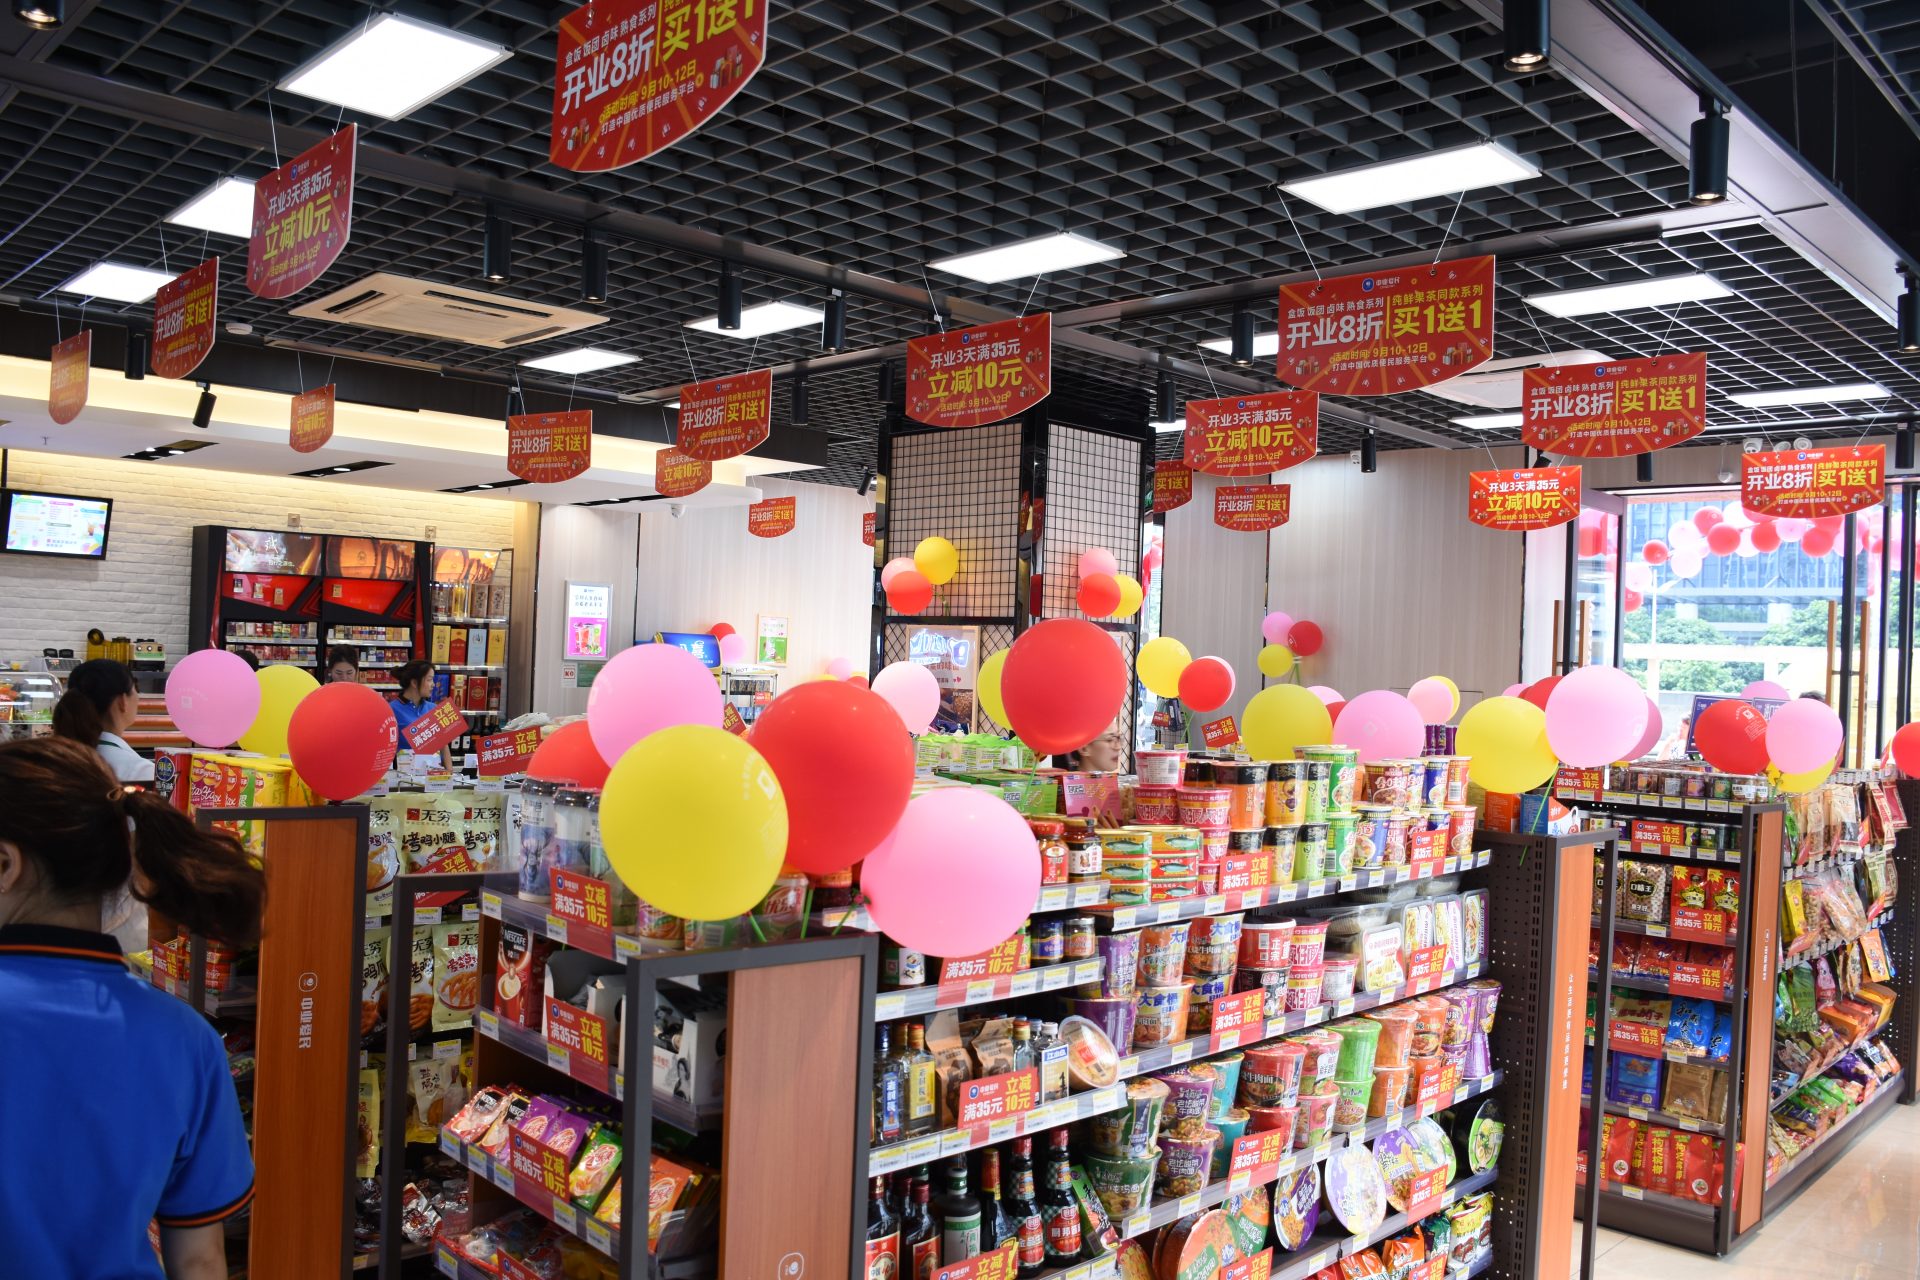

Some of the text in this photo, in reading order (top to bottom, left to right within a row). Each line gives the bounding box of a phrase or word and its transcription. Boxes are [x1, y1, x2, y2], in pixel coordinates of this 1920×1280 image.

[561, 25, 656, 116] 开业8折
[601, 81, 695, 136] 打造中国优质便民服务平台
[268, 165, 332, 219] 开业3天满35元
[263, 193, 332, 261] 立减10元
[1392, 284, 1483, 306] 纯鲜果茶同款系列
[156, 308, 185, 343] 开业8折
[186, 296, 212, 328] 买1送1
[1286, 299, 1481, 351] 开业8折 买1送1
[930, 339, 1021, 369] 开业3天满35元
[1332, 354, 1428, 372] 打造中国优质便民服务平台
[927, 358, 1023, 399] 立减10元
[1530, 386, 1696, 421] 开业8折 买1送1
[682, 406, 725, 431] 开业8折
[727, 399, 766, 423] 买1送1
[1207, 407, 1292, 429] 开业3天满35元
[1204, 424, 1294, 453] 立减10元
[1569, 427, 1651, 439] 打造中国优质便民服务平台
[511, 435, 588, 455] 开业8折 买1送1
[664, 462, 702, 482] 立减10元
[1747, 467, 1877, 491] 开业8折 买1送1
[1156, 477, 1189, 490] 买1送1
[1488, 479, 1560, 493] 开业3天满35元
[1218, 499, 1287, 512] 开业8折 买1送1
[1486, 492, 1561, 512] 立减10元
[750, 510, 794, 523] 开业8折 买1送1
[434, 701, 454, 720] 立减
[439, 713, 459, 728] 10元
[412, 723, 440, 747] 满35元
[515, 730, 537, 744] 立减
[481, 745, 515, 762] 满35元
[516, 743, 537, 755] 10元
[1556, 778, 1581, 787] 满35元
[1582, 772, 1599, 781] 立减
[1583, 780, 1599, 789] 10元
[421, 809, 450, 822] 无穷
[473, 807, 500, 820] 无穷
[1634, 831, 1660, 841] 满35元
[1662, 825, 1680, 836] 立减
[1662, 834, 1680, 844] 10元
[442, 851, 466, 872] 立减
[1250, 855, 1268, 871] 立减
[1222, 872, 1249, 889] 满35元
[1250, 870, 1268, 886] 10元
[584, 883, 607, 906] 立减
[554, 893, 585, 919] 满35元
[585, 904, 608, 928] 10元
[1674, 917, 1702, 929] 满35元
[1703, 913, 1722, 924] 立减
[1703, 922, 1722, 932] 10元
[945, 957, 986, 979] 满35元
[988, 955, 1014, 974] 10元
[1701, 968, 1720, 979] 立减
[1672, 972, 1700, 984] 满35元
[1701, 977, 1720, 987] 10元
[1243, 992, 1262, 1010] 立减
[1214, 1011, 1242, 1031] 满35元
[1243, 1006, 1260, 1022] 10元
[550, 1020, 581, 1050] 满35元
[580, 1015, 603, 1041] 立减
[1613, 1029, 1640, 1042] 满35元
[1640, 1027, 1658, 1038] 立减
[581, 1038, 605, 1062] 10元
[1640, 1035, 1659, 1046] 10元
[1005, 1073, 1033, 1095] 立减
[963, 1097, 1003, 1122] 满35元
[1005, 1092, 1031, 1112] 10元
[1261, 1132, 1281, 1150] 立减
[542, 1150, 566, 1177] 立减
[1233, 1151, 1260, 1170] 满35元
[1261, 1147, 1279, 1164] 10元
[513, 1150, 543, 1183] 满35元
[542, 1170, 566, 1199] 10元
[976, 1253, 1004, 1276] 立减
